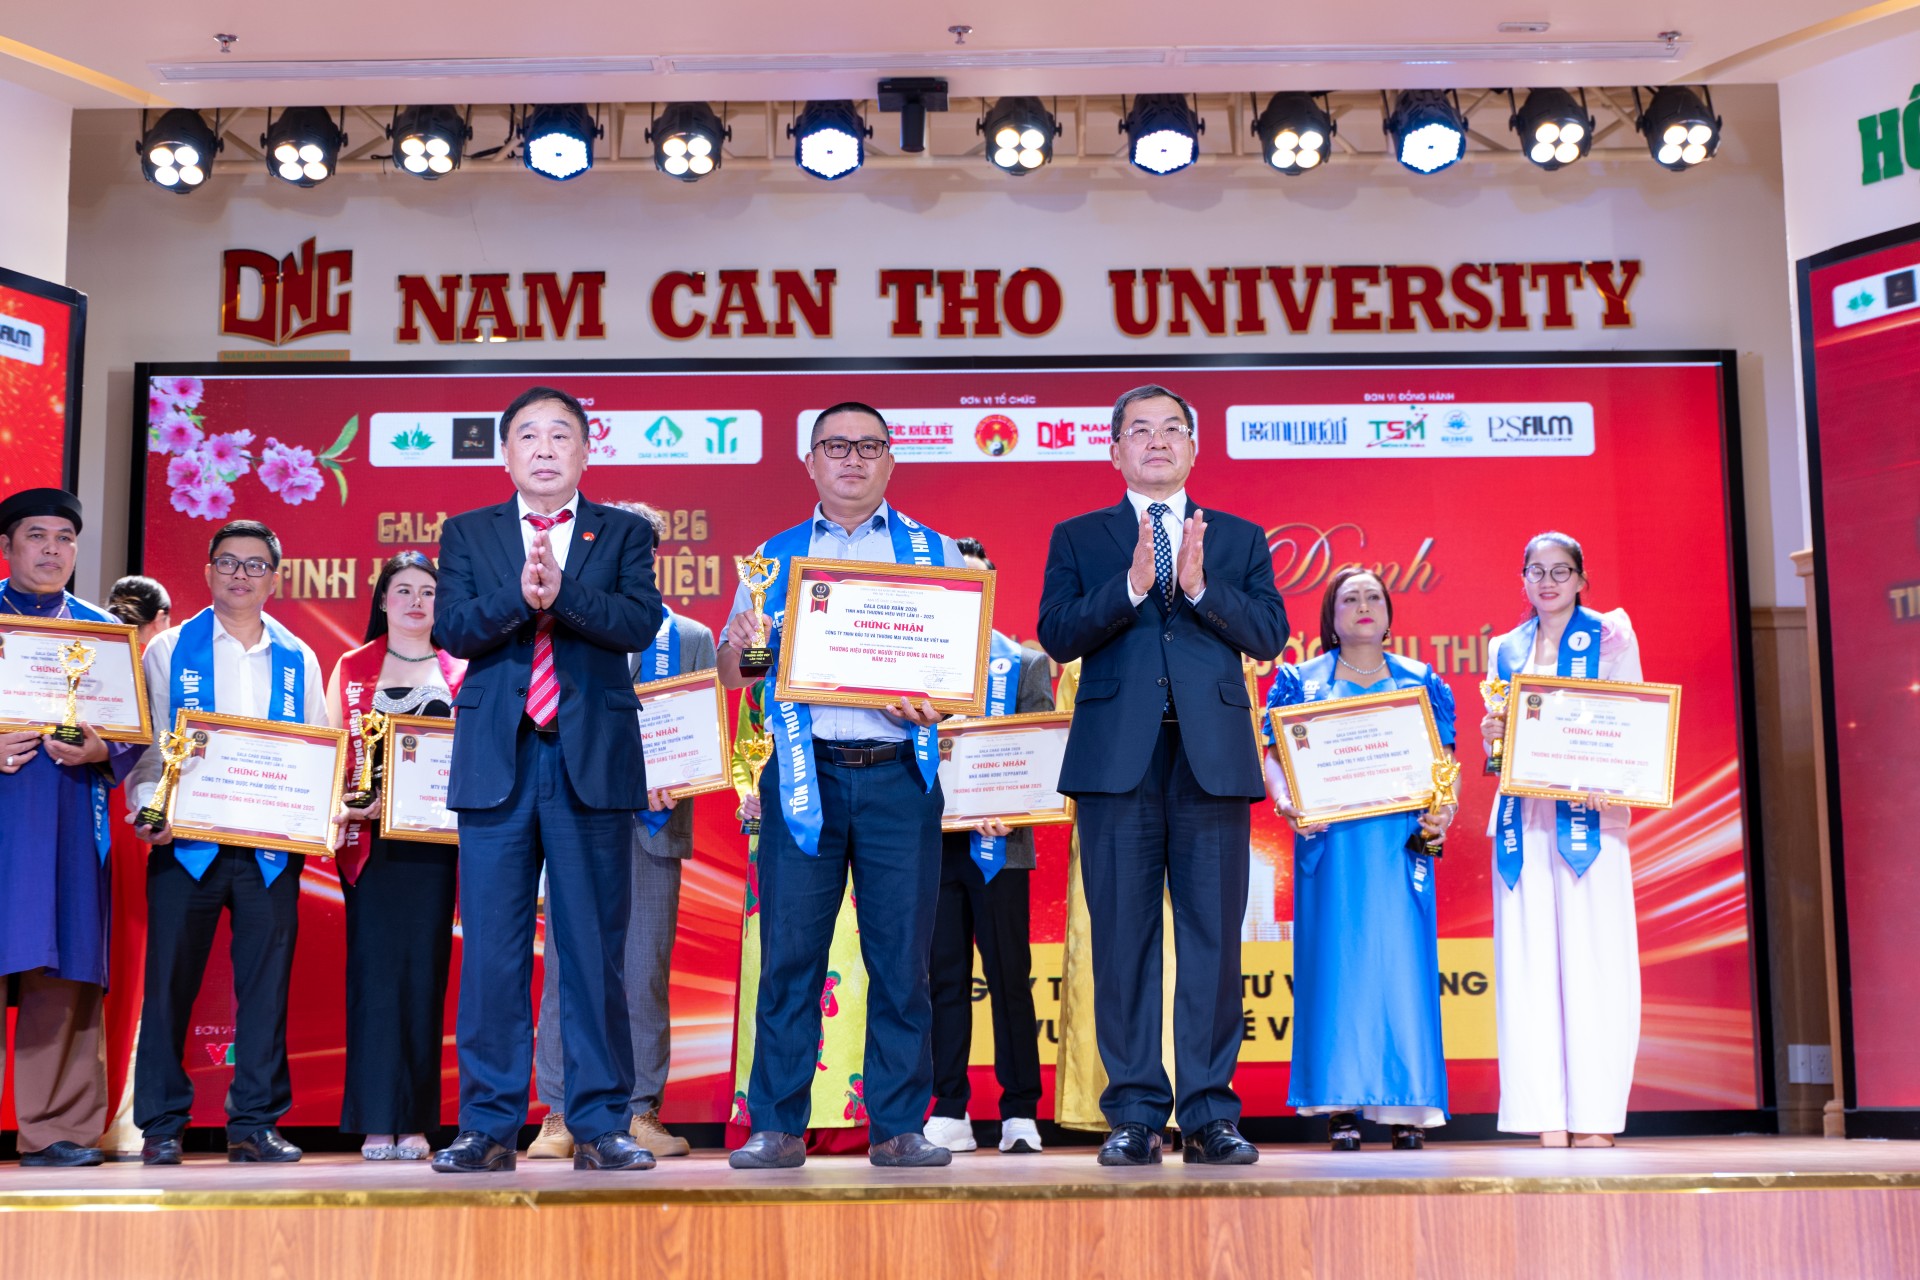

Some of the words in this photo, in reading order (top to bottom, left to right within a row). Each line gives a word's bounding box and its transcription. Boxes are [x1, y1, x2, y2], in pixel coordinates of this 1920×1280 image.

[219, 235, 353, 346] DNC
[397, 270, 606, 343] NAM
[650, 269, 838, 339] CAN
[879, 266, 1063, 339] THO
[1108, 260, 1641, 337] UNIVERSITY
[1081, 423, 1111, 432] NAM
[1368, 420, 1425, 440] TSM
[378, 512, 447, 543] GALA
[274, 558, 356, 599] TINH
[854, 620, 890, 630] CHỨNG
[894, 623, 923, 633] NHẬN
[1575, 637, 1582, 646] 7
[655, 652, 669, 676] HOA
[996, 661, 1003, 671] 4
[284, 666, 296, 690] TINH
[992, 676, 1007, 700] TINH
[283, 692, 296, 718] HOA
[779, 701, 800, 743] THƯƠ
[917, 725, 931, 747] ẦN
[791, 743, 806, 783] VINH
[789, 784, 808, 815] TÔN
[346, 823, 361, 847] TÔN
[1502, 830, 1517, 854] TÔN
